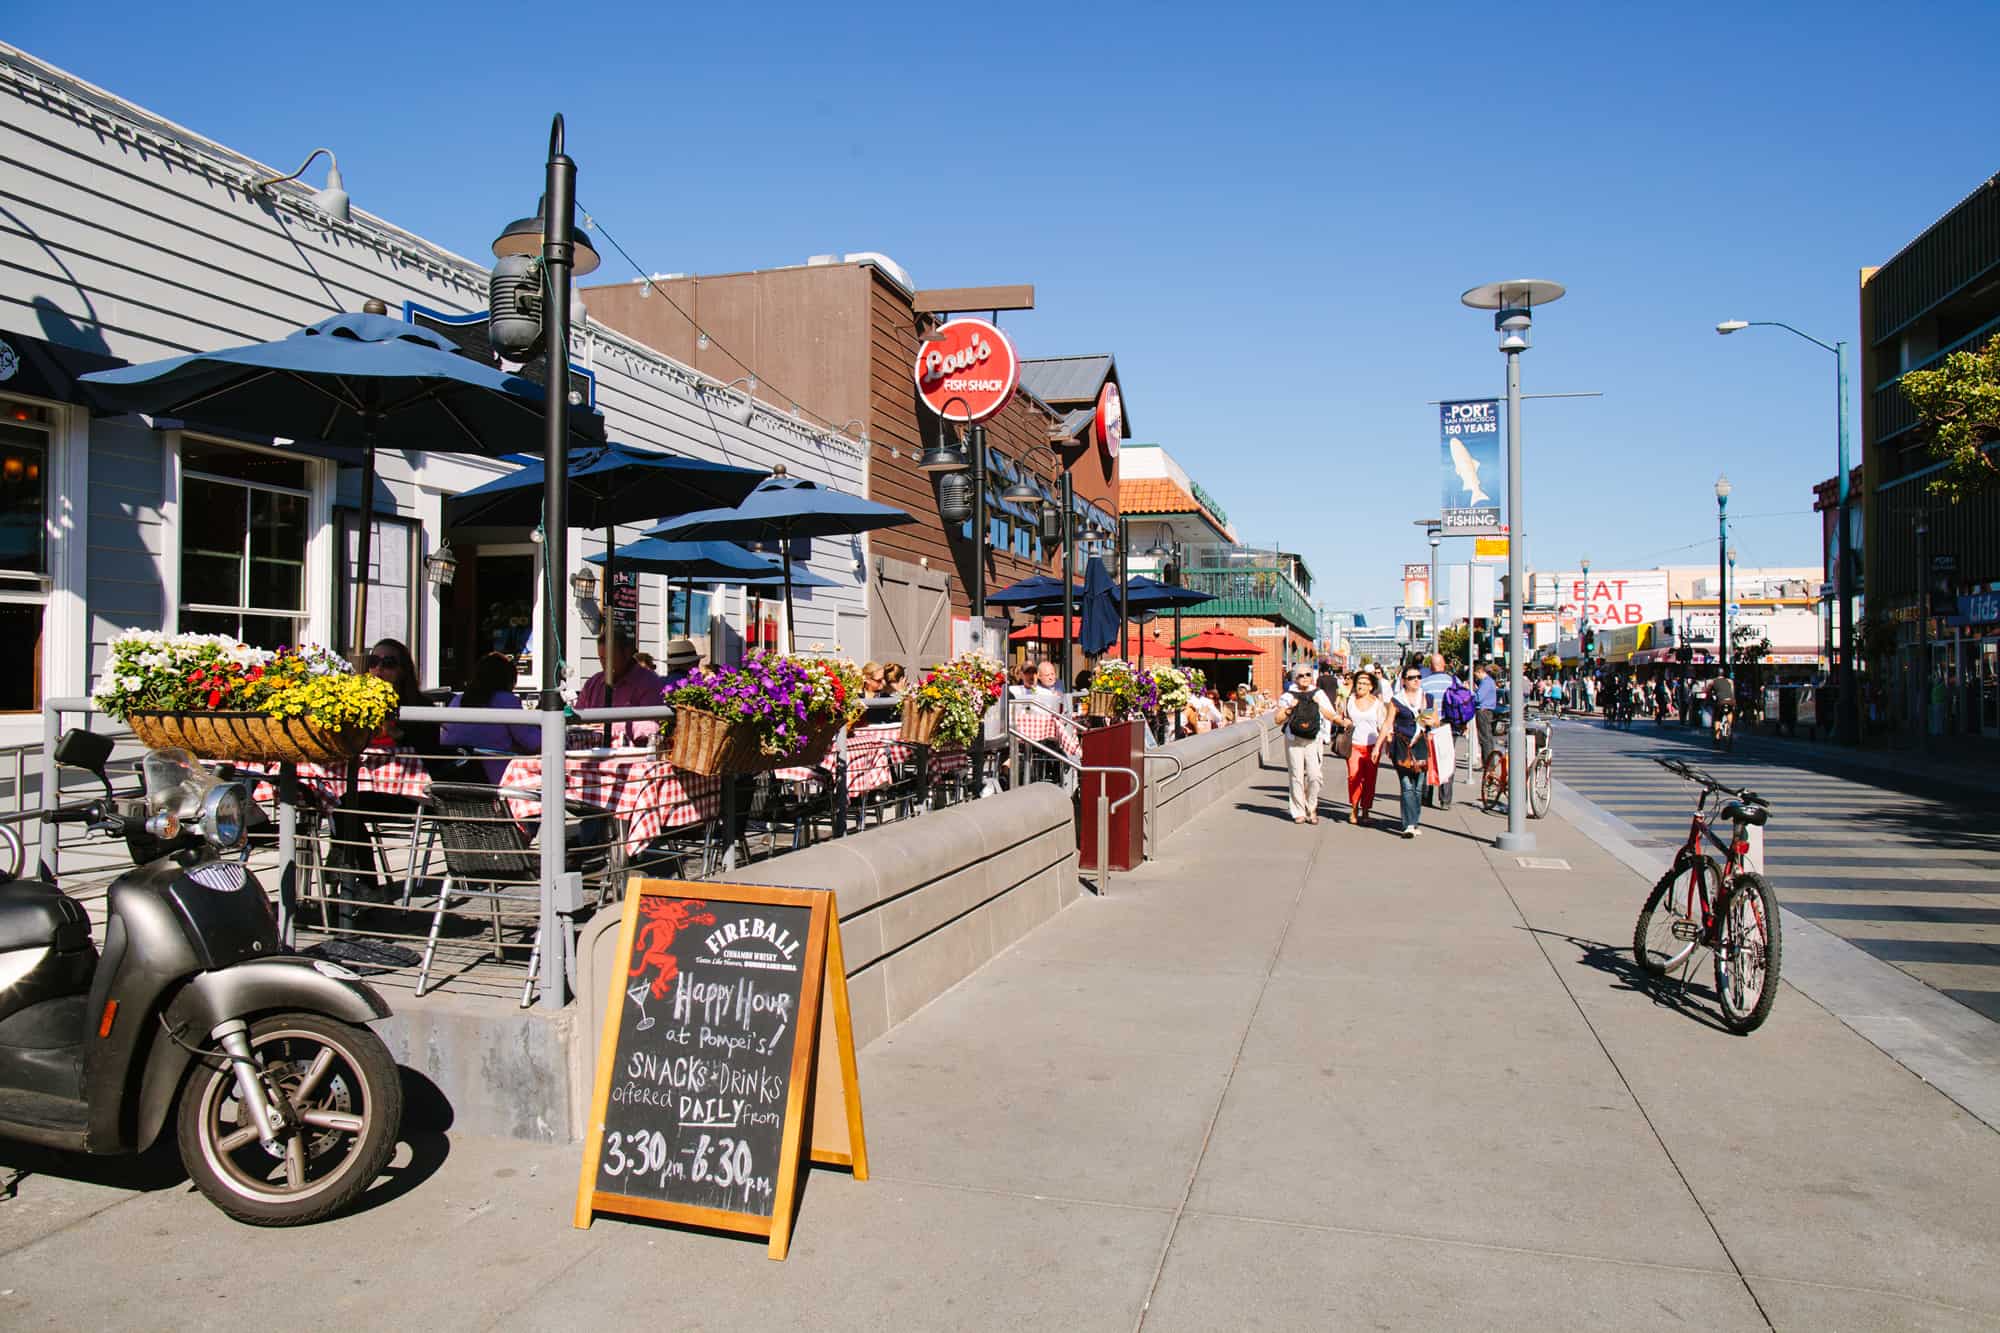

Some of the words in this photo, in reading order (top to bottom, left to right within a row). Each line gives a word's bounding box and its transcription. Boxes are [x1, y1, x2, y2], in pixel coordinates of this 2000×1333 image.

[925, 333, 991, 382] Lou's
[944, 380, 967, 391] FISH
[968, 380, 1002, 391] SHACK
[1452, 404, 1489, 418] PORT
[1445, 424, 1462, 434] 150
[1464, 422, 1497, 432] YEARS
[1447, 514, 1497, 527] FISHING
[1573, 580, 1628, 601] EAT
[1562, 604, 1644, 624] CRAB
[1969, 595, 1999, 624] Lids
[705, 918, 800, 960] FIREBALL
[673, 971, 735, 1026] Happy
[666, 1026, 692, 1045] at
[679, 1096, 745, 1124] DAILY
[603, 1129, 667, 1177] 3:30
[691, 1133, 753, 1188] 6:30
